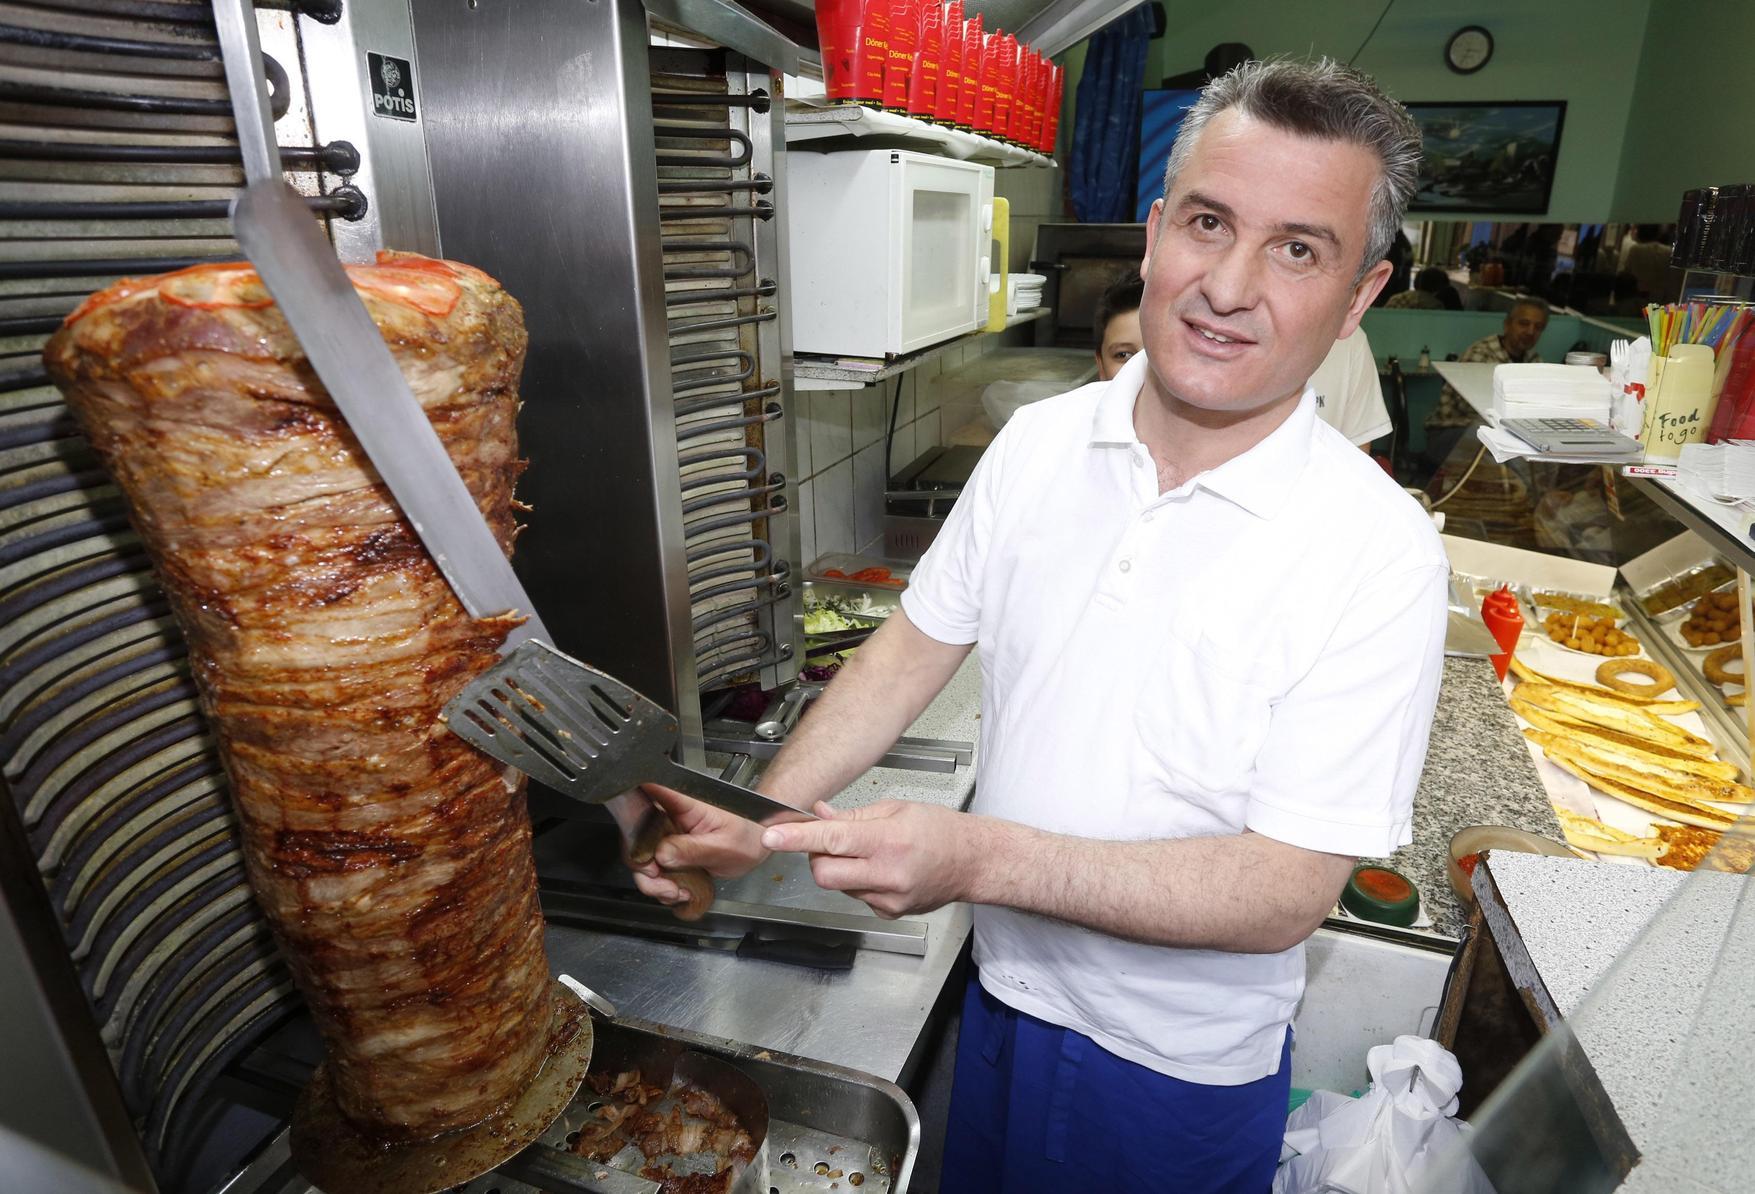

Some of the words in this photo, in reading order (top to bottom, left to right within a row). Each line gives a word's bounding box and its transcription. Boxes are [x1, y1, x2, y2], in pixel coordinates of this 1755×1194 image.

[865, 37, 883, 48] Döner
[889, 50, 906, 60] Döner
[1659, 408, 1700, 429] Food
[1660, 430, 1673, 442] to
[1674, 427, 1697, 445] go
